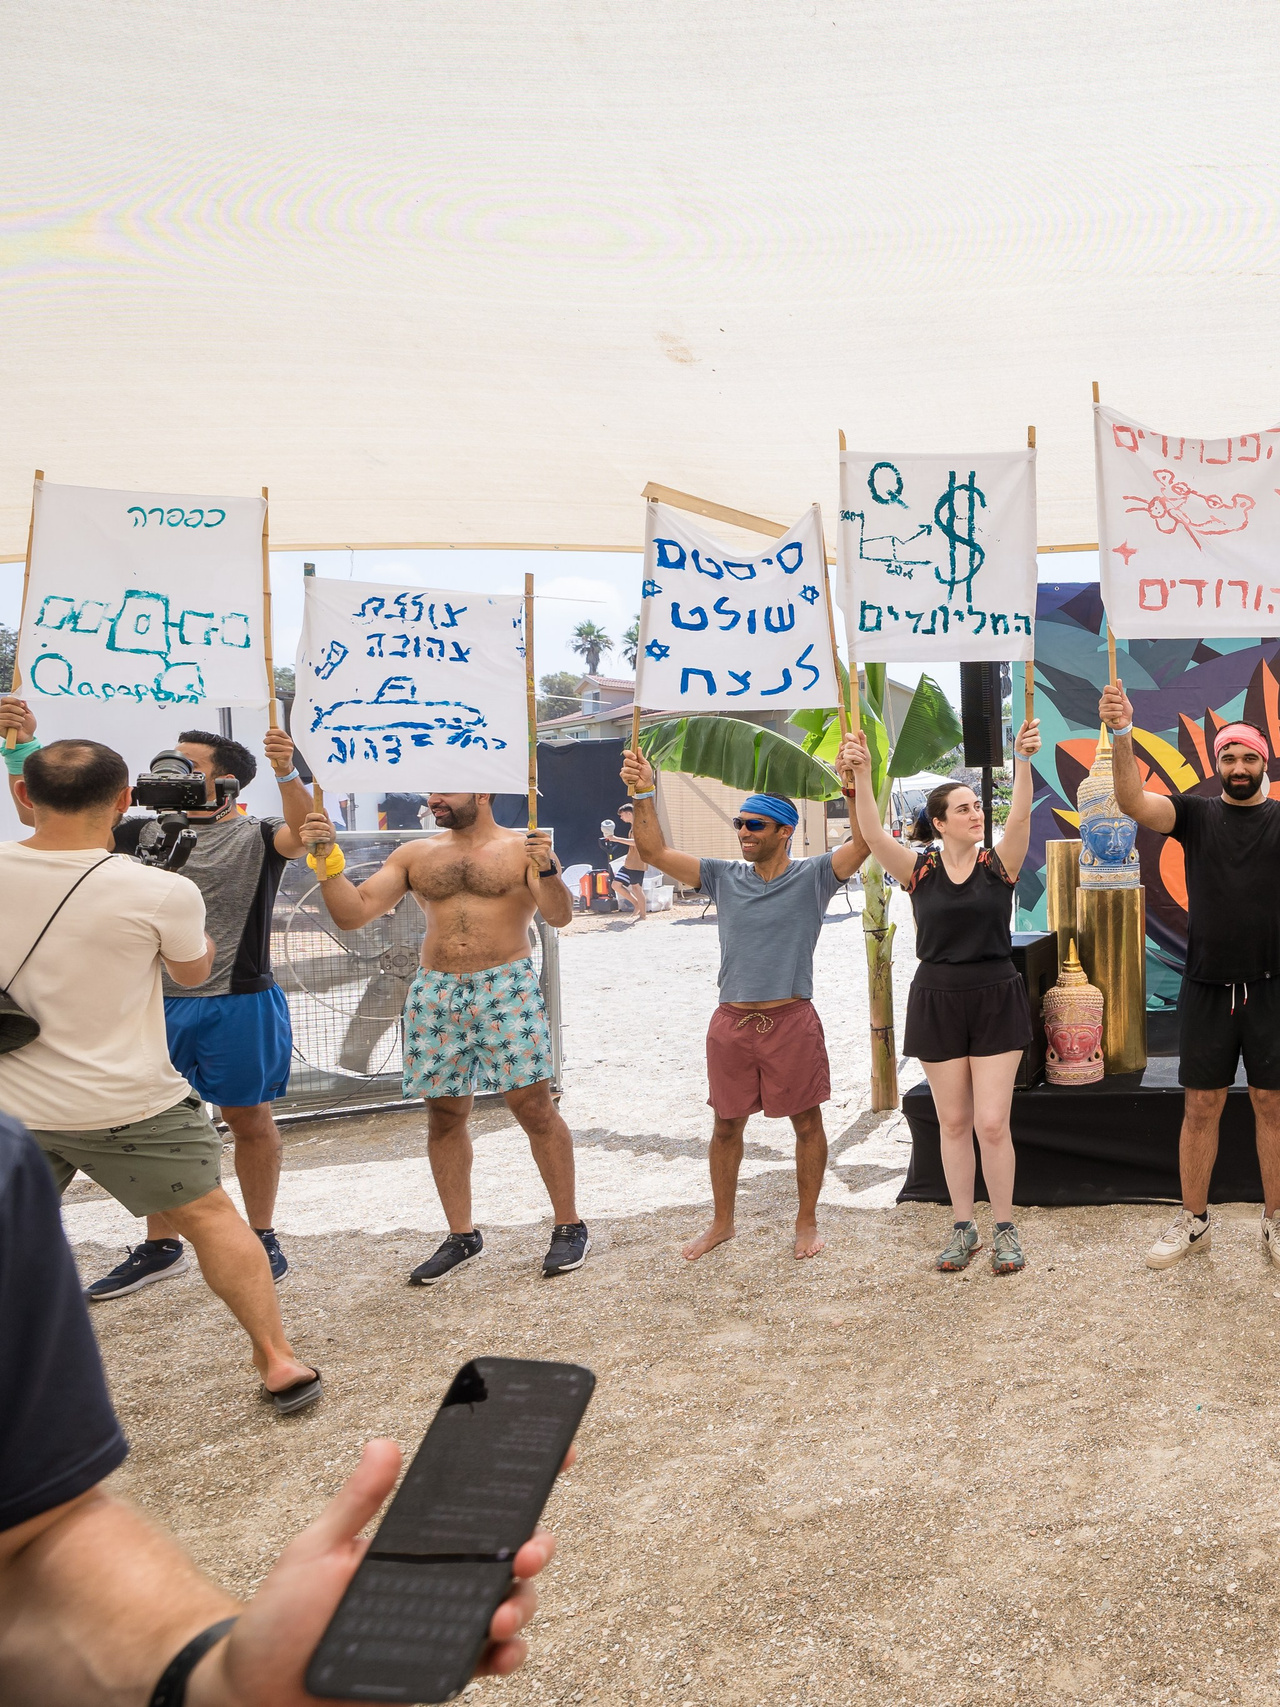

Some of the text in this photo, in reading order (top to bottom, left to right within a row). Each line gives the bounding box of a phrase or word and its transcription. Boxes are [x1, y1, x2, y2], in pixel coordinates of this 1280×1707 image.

[867, 462, 909, 509] Q
[128, 506, 225, 528] כפפרה
[653, 538, 803, 580] סיסטם
[671, 597, 795, 634] שולט
[366, 633, 471, 663] צהובה
[681, 644, 819, 696] לנצח
